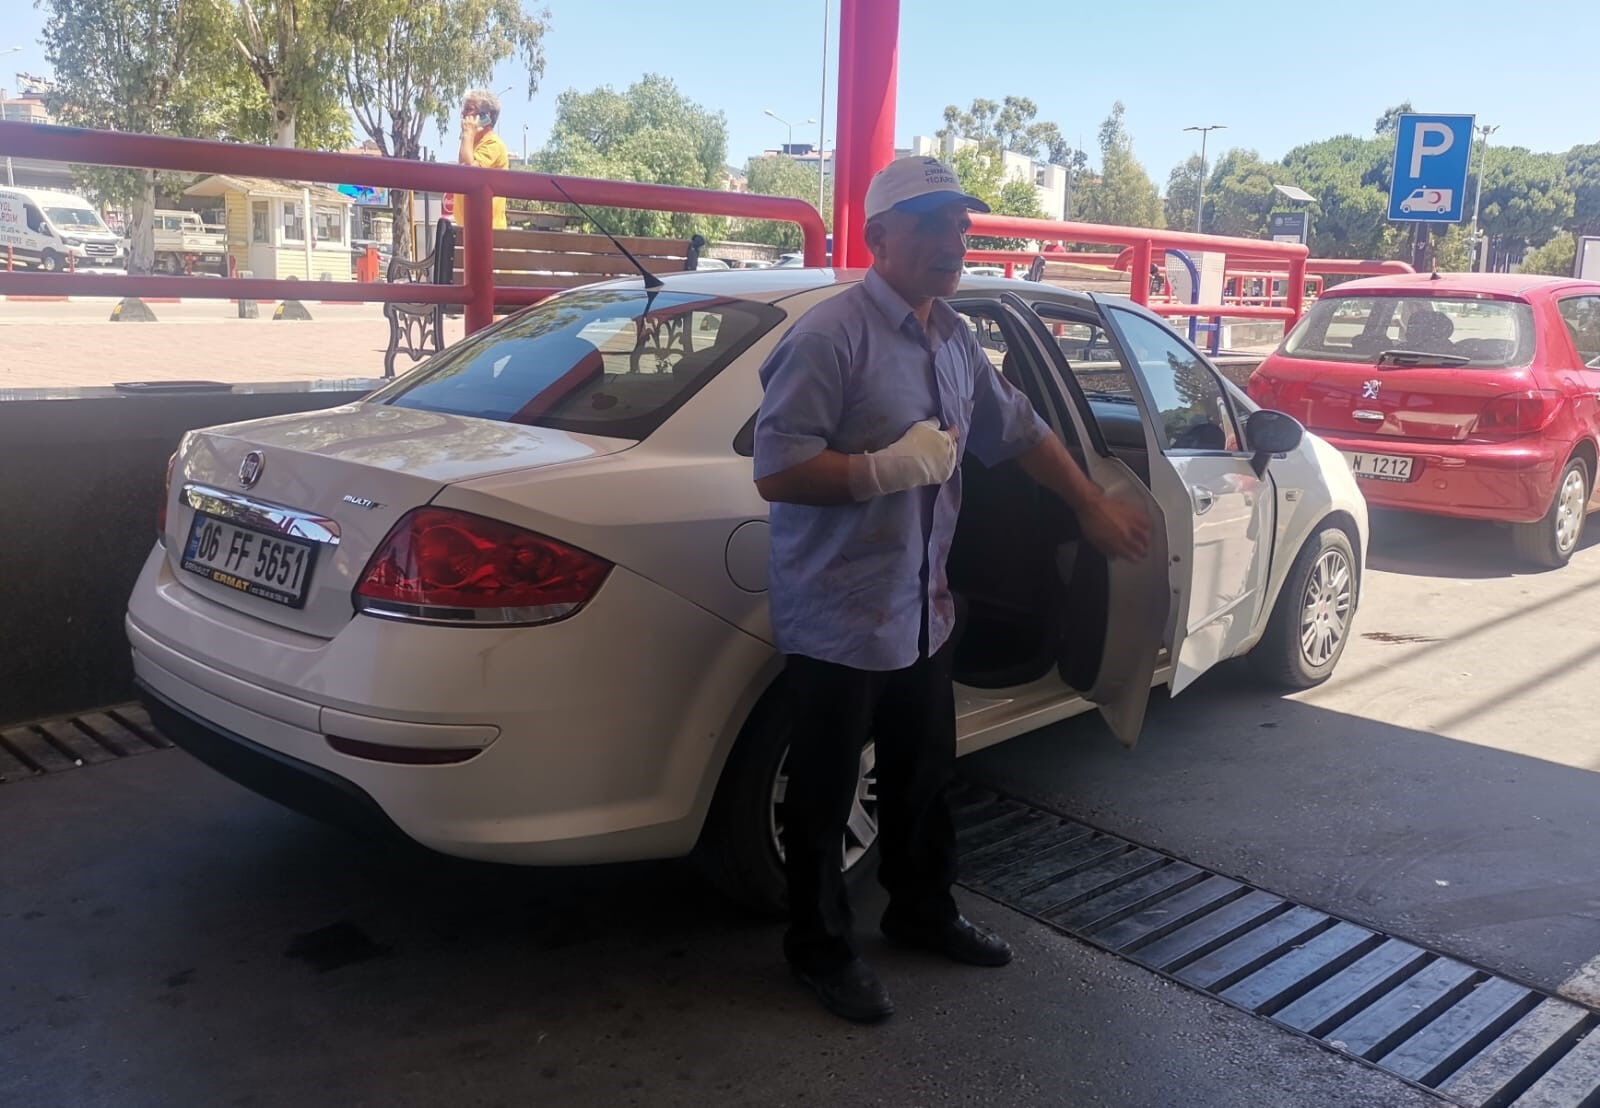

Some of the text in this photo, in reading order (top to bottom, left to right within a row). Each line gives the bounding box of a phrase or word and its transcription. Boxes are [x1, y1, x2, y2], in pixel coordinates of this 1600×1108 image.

[1409, 122, 1455, 178] P
[1372, 457, 1409, 476] 1212
[198, 522, 305, 590] 06 FF 5651
[212, 570, 250, 591] ERMAT
